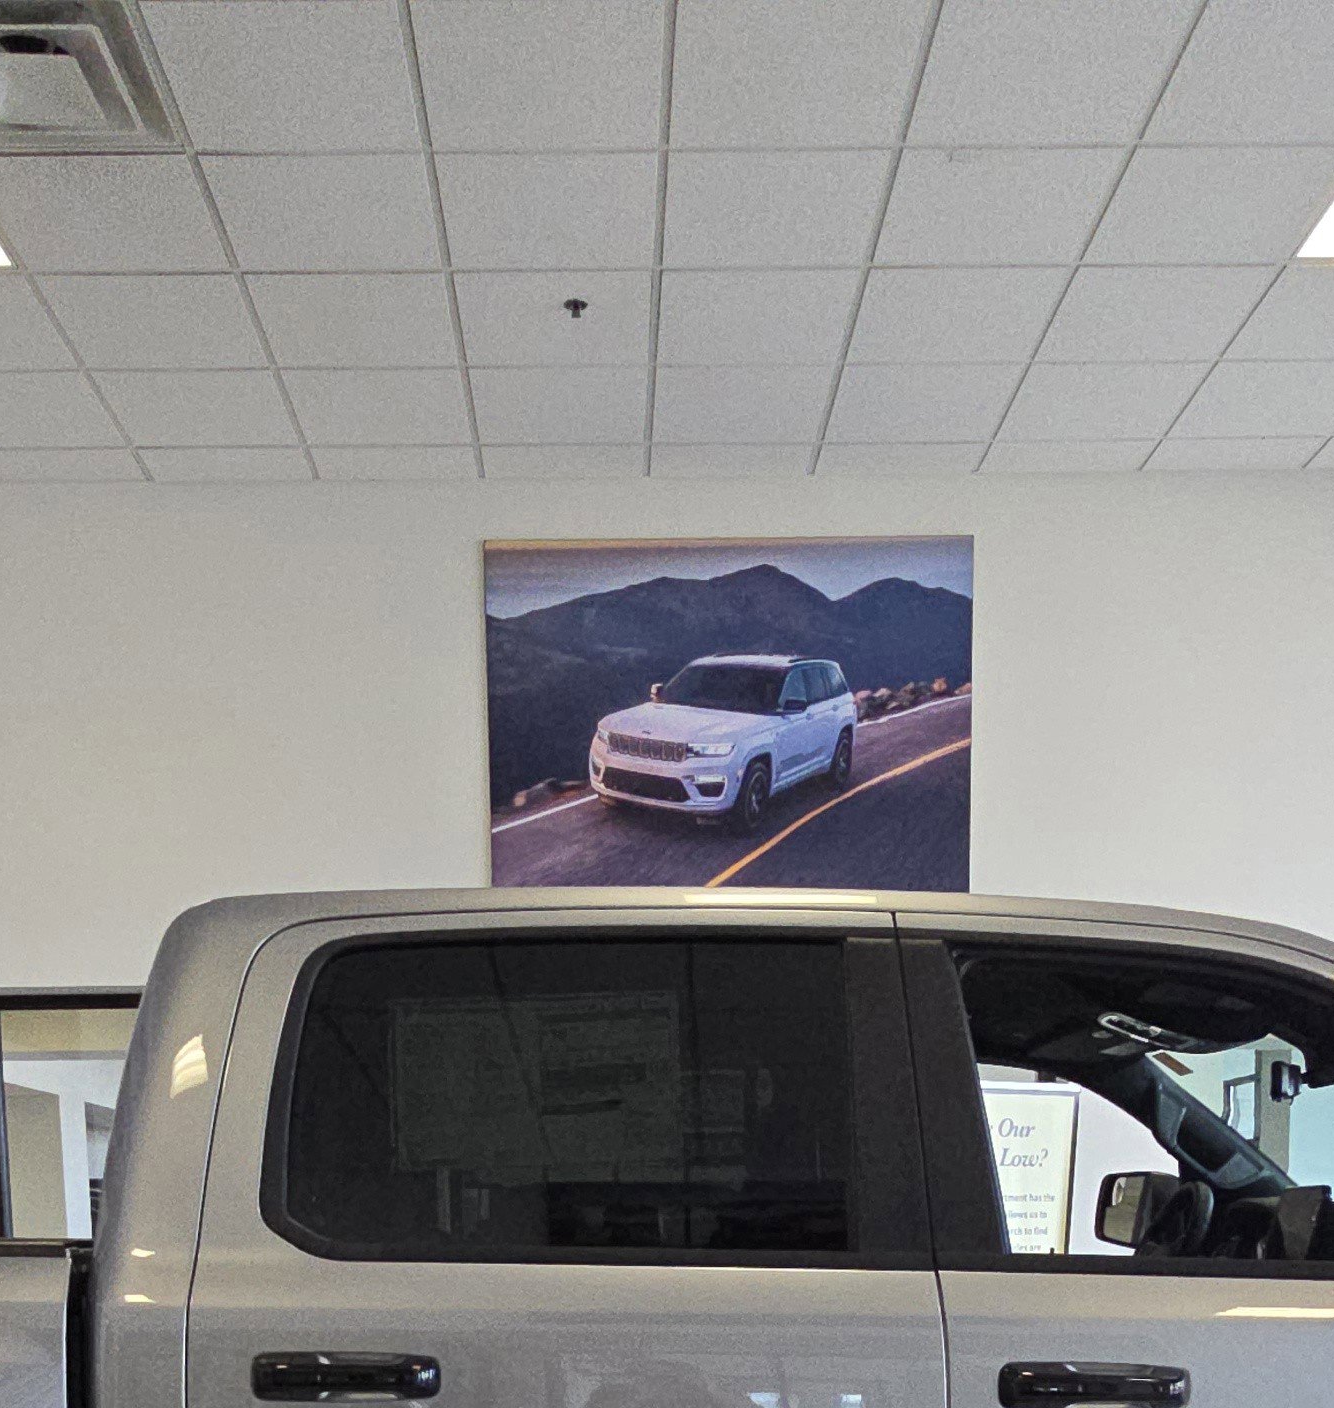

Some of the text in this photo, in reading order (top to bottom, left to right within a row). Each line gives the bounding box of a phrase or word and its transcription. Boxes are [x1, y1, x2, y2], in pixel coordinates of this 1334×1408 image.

[998, 1117, 1035, 1138] Our
[999, 1147, 1049, 1168] Low?
[1003, 1194, 1027, 1202] tment
[1010, 1227, 1023, 1236] rch
[1024, 1227, 1033, 1236] to
